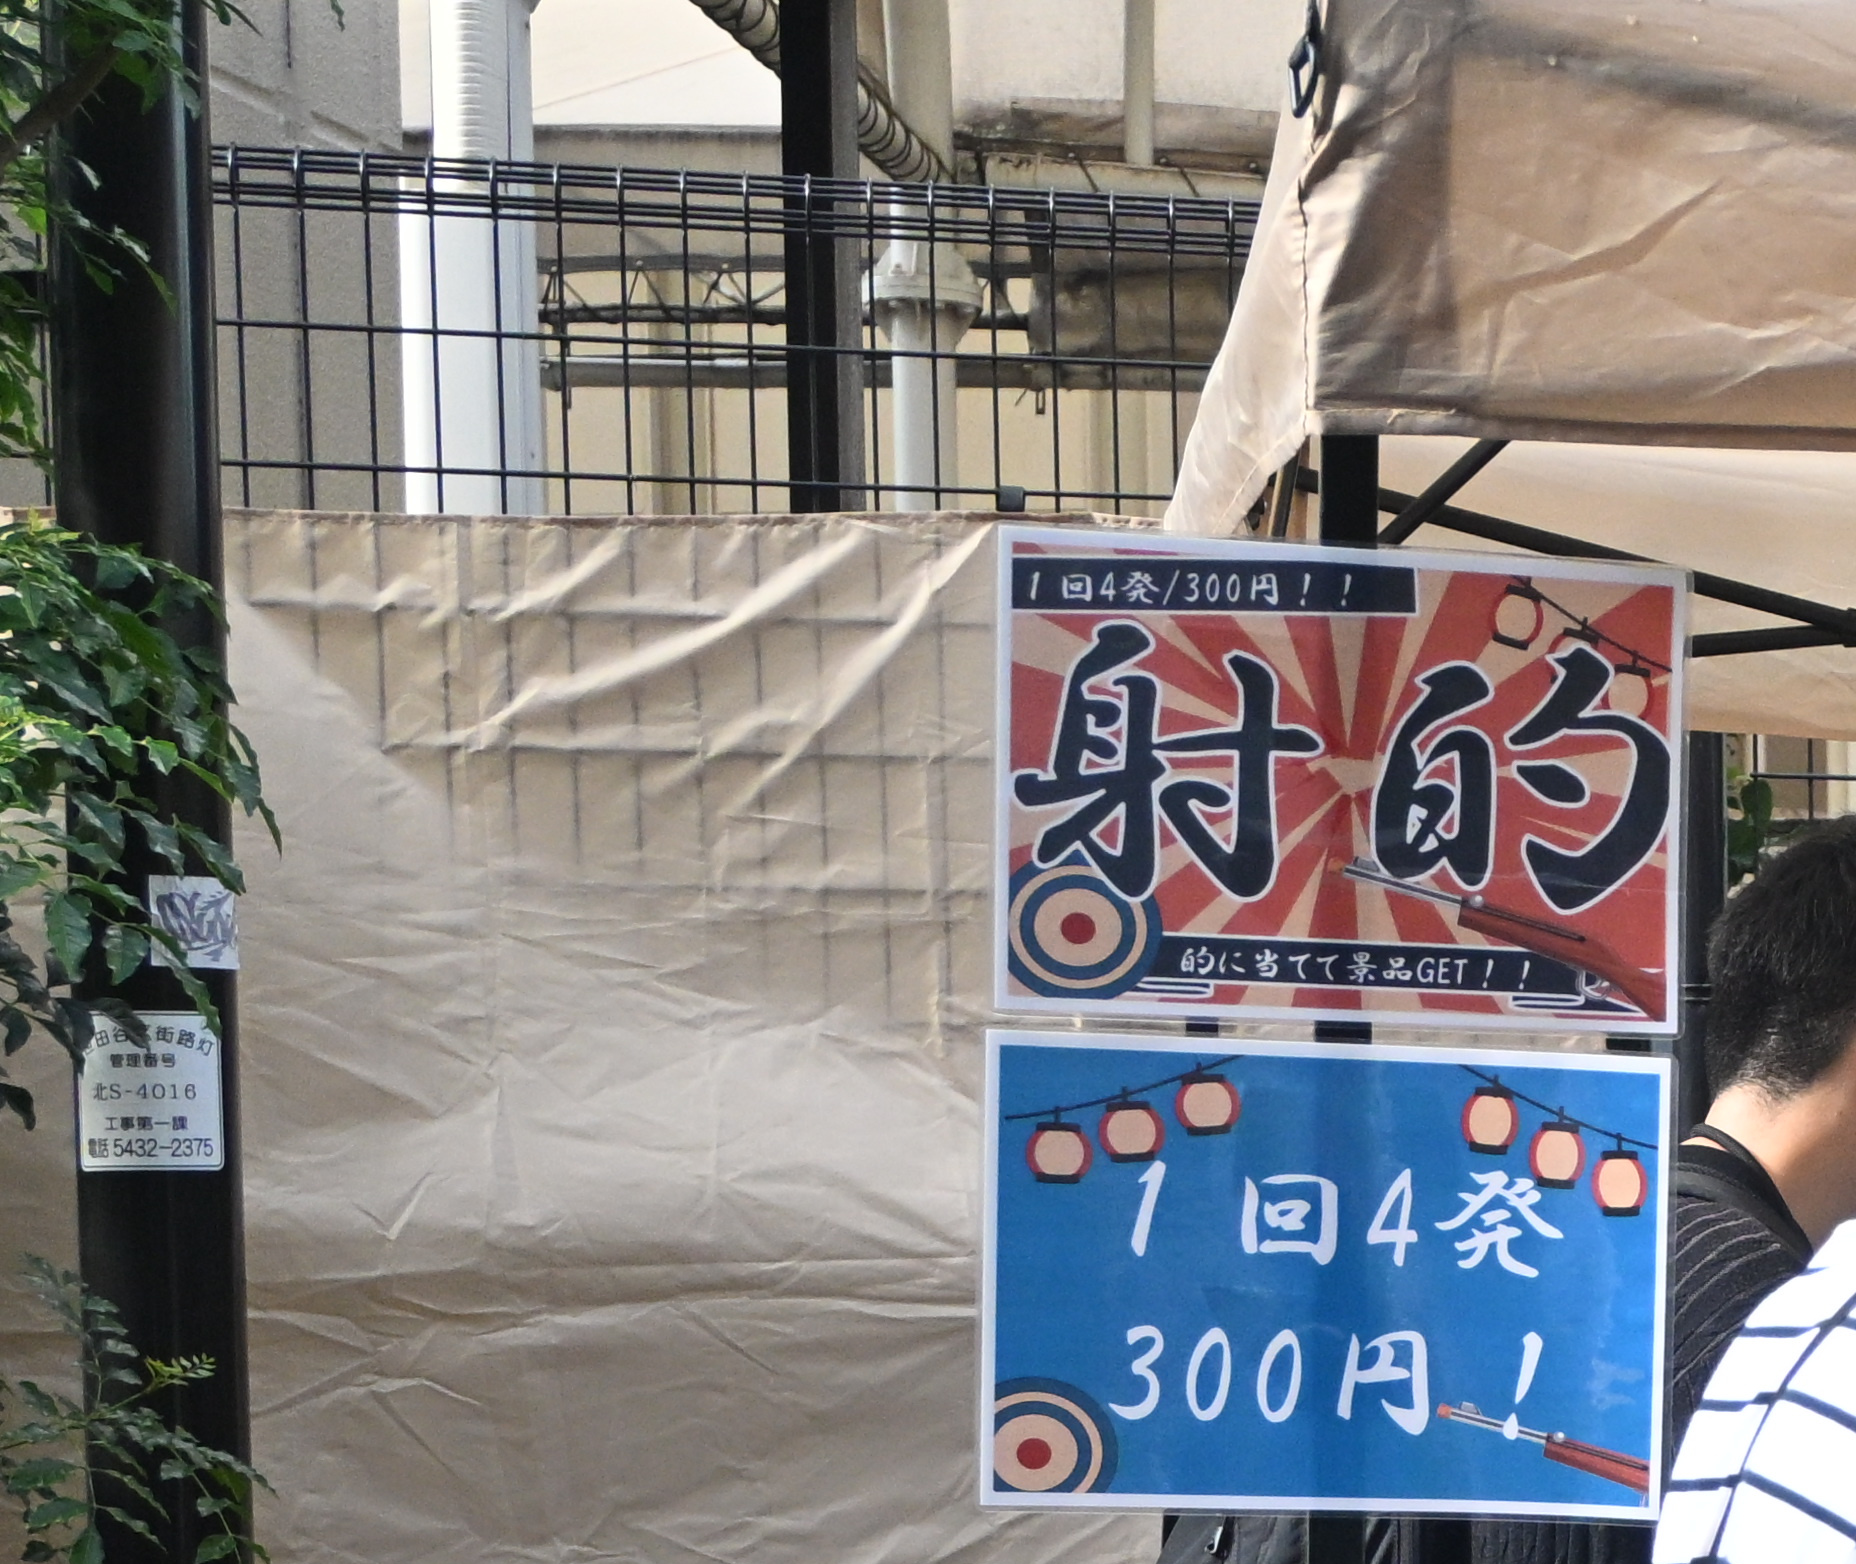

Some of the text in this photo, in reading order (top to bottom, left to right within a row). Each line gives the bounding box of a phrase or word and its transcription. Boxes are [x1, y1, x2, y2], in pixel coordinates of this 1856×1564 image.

[1013, 619, 1671, 913] 射的
[84, 1025, 216, 1056] 田谷街路灯
[110, 1053, 176, 1068] 管理番号
[105, 1116, 188, 1131] 工事第一課
